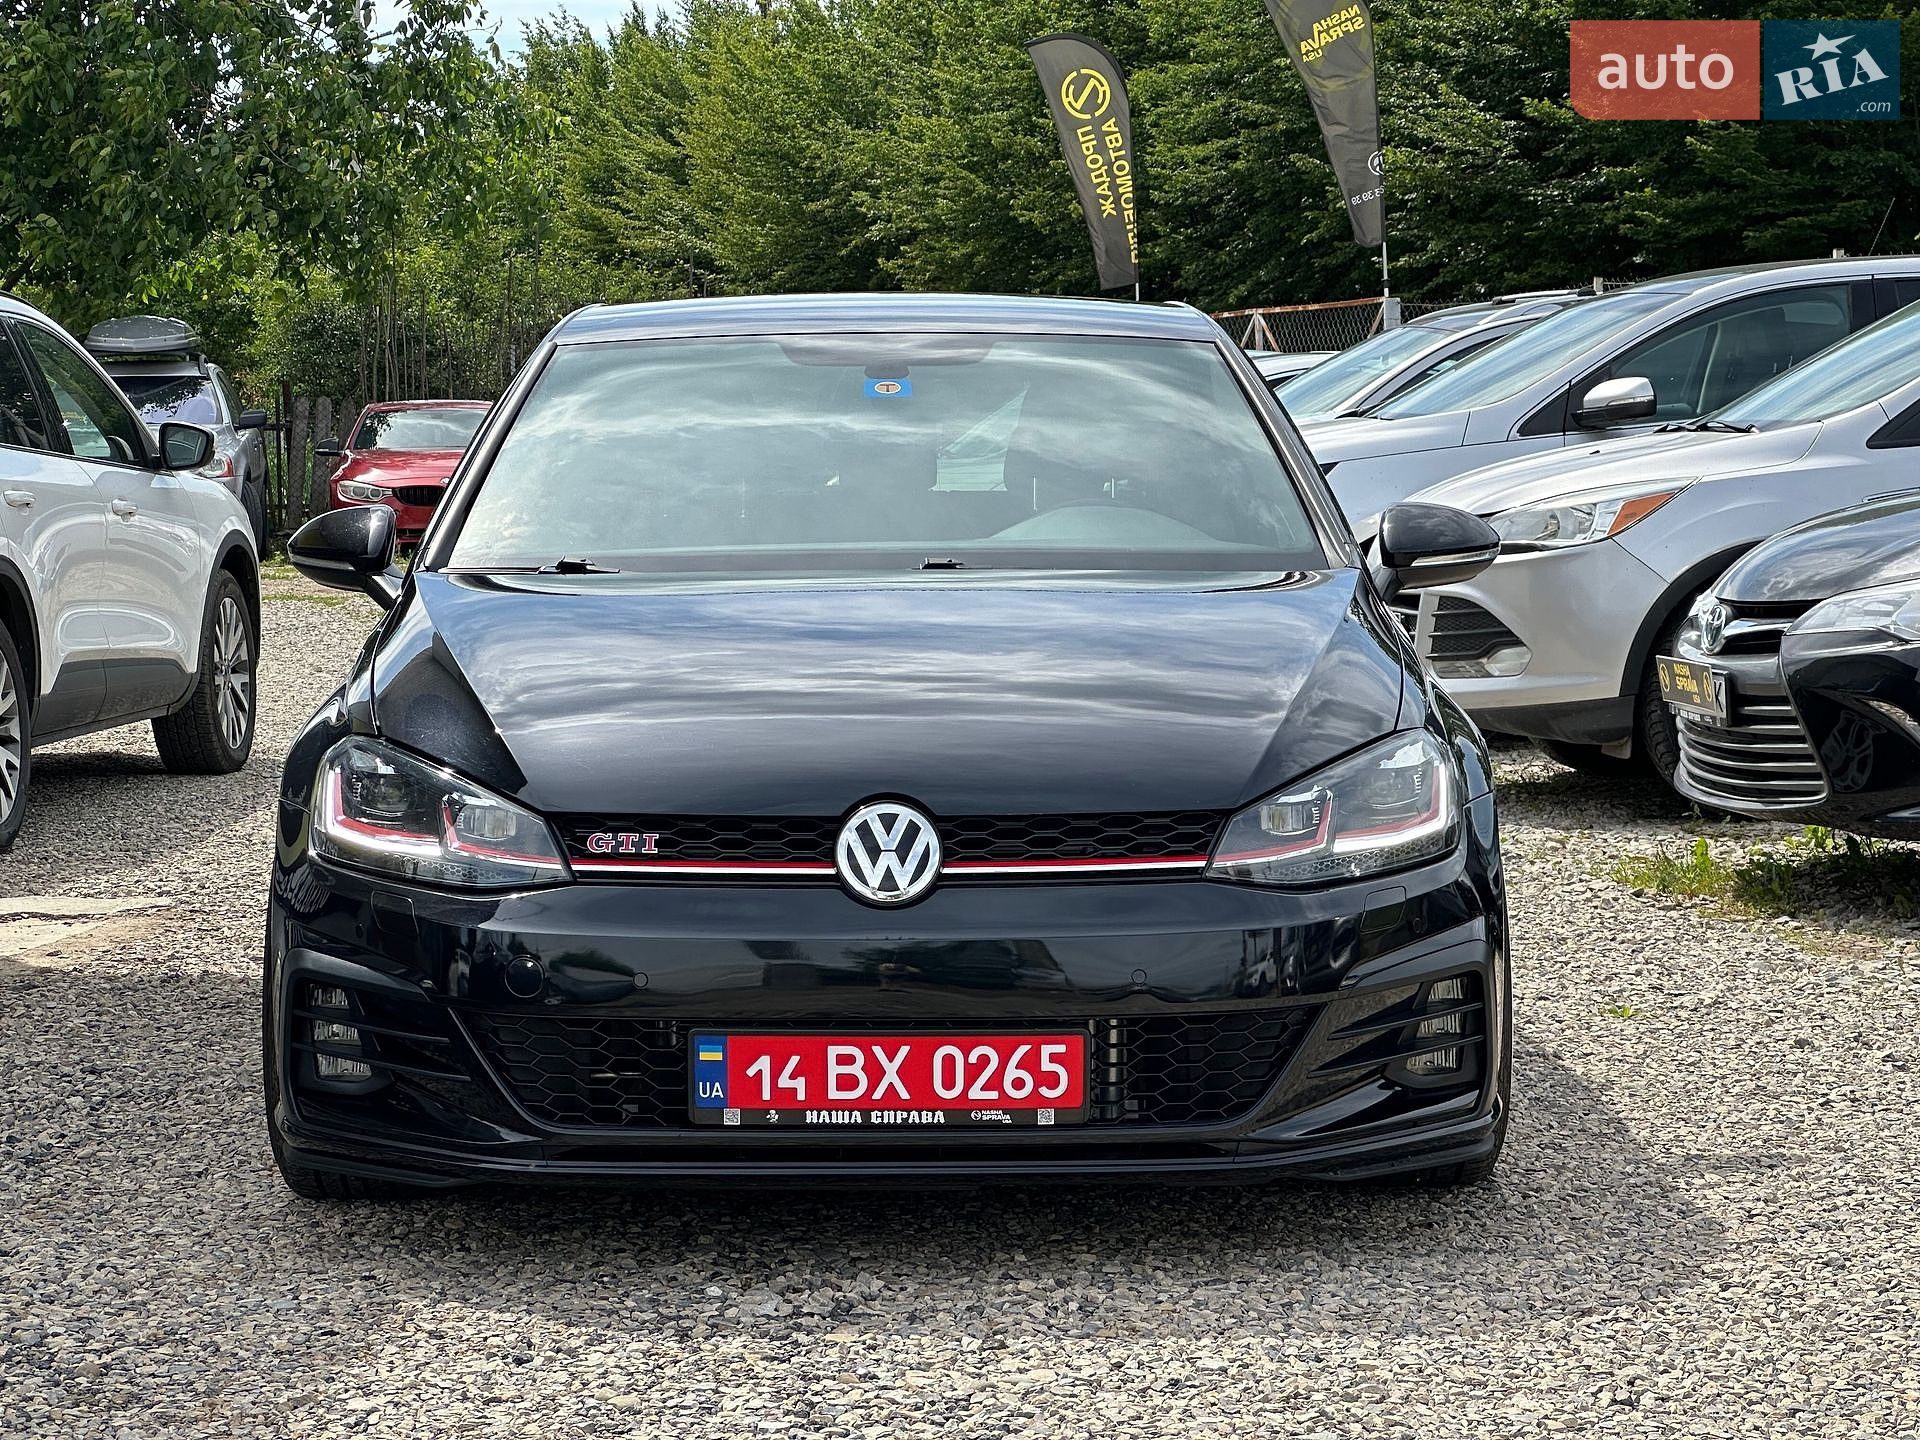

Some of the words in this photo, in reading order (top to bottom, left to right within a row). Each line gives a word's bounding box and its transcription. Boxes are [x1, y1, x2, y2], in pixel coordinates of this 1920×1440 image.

[586, 833, 659, 854] GTI
[745, 1055, 806, 1101] 14
[826, 1045, 911, 1100] BX
[932, 1044, 1069, 1100] 0265
[699, 1081, 724, 1099] UA
[805, 1109, 863, 1124] НАША
